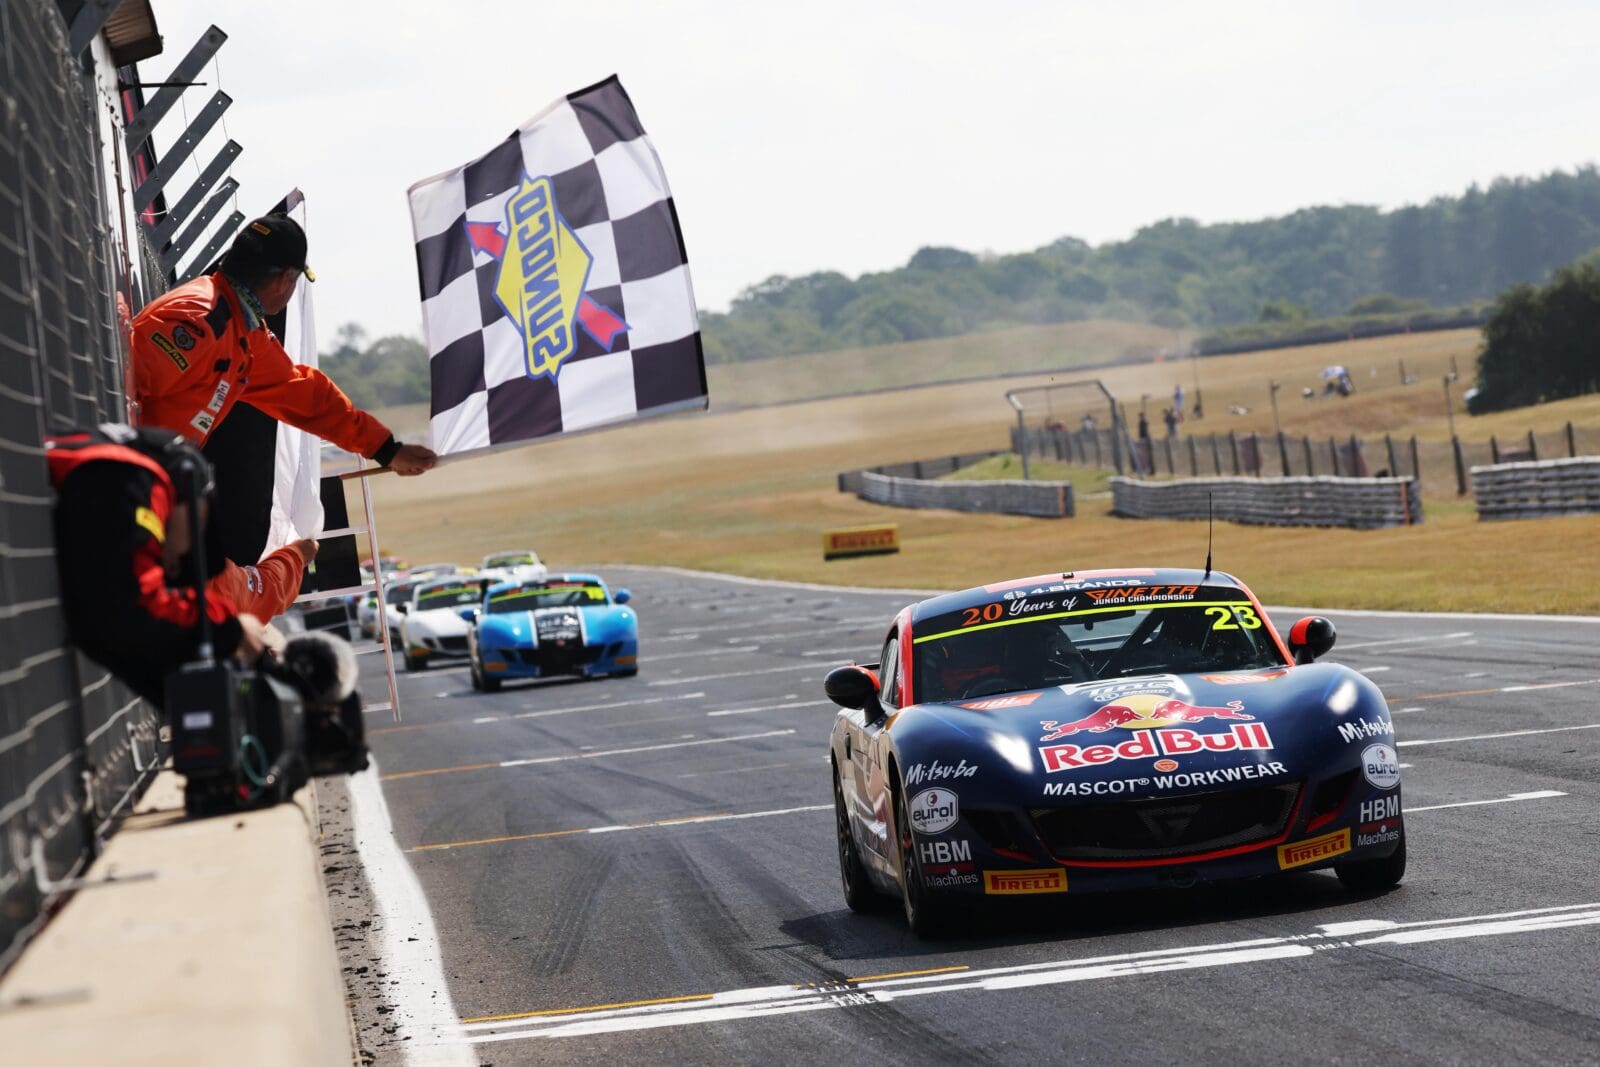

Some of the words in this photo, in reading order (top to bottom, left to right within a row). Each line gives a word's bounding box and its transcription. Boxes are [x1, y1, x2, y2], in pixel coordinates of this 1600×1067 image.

[1084, 585, 1199, 600] GINETTA
[1093, 597, 1126, 606] JUNIOR
[1128, 594, 1194, 603] CHAMPIONSHIP
[962, 602, 1004, 627] 20
[1009, 599, 1056, 616] Years
[1062, 596, 1078, 611] of
[1205, 606, 1262, 630] 23
[1040, 730, 1158, 773] Red
[1157, 722, 1273, 755] Bull
[1153, 761, 1288, 790] WORKWEAR
[913, 801, 953, 821] eurol
[1360, 795, 1399, 824] HBM
[1284, 833, 1345, 865] PIRELLI
[1357, 829, 1399, 846] Machines
[920, 840, 972, 864] HBM
[926, 871, 979, 888] Machines
[991, 872, 1061, 890] PIRELLI
